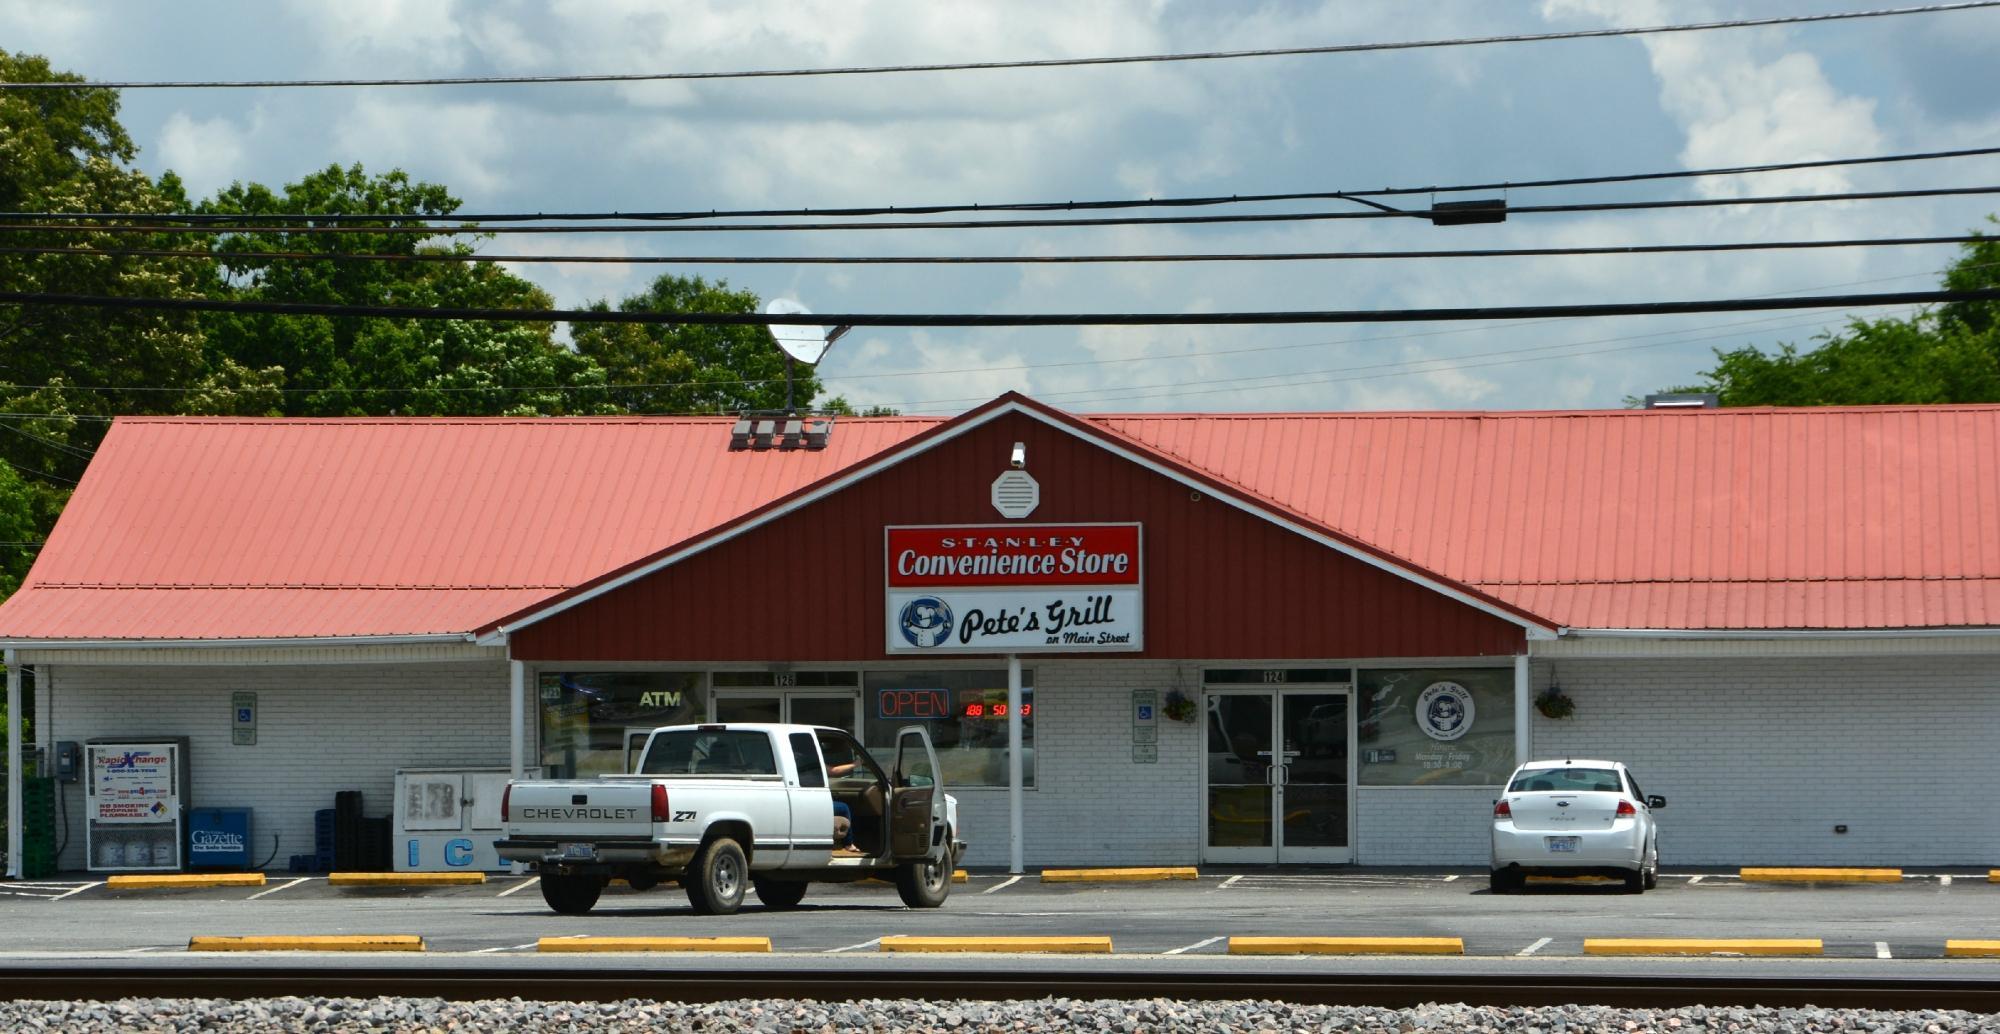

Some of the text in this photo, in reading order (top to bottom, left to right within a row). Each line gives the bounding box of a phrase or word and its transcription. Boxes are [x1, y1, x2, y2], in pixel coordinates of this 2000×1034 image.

[898, 547, 1129, 576] Convenience Store
[959, 594, 1116, 644] Pete's Grill
[1046, 631, 1130, 645] on Main Street
[1266, 671, 1283, 683] 124
[639, 691, 682, 707] ATM
[881, 691, 947, 716] OPEN
[993, 703, 1007, 716] 50
[523, 808, 638, 819] CHEVROLET
[673, 811, 697, 823] Z71
[191, 830, 243, 845] Gazette
